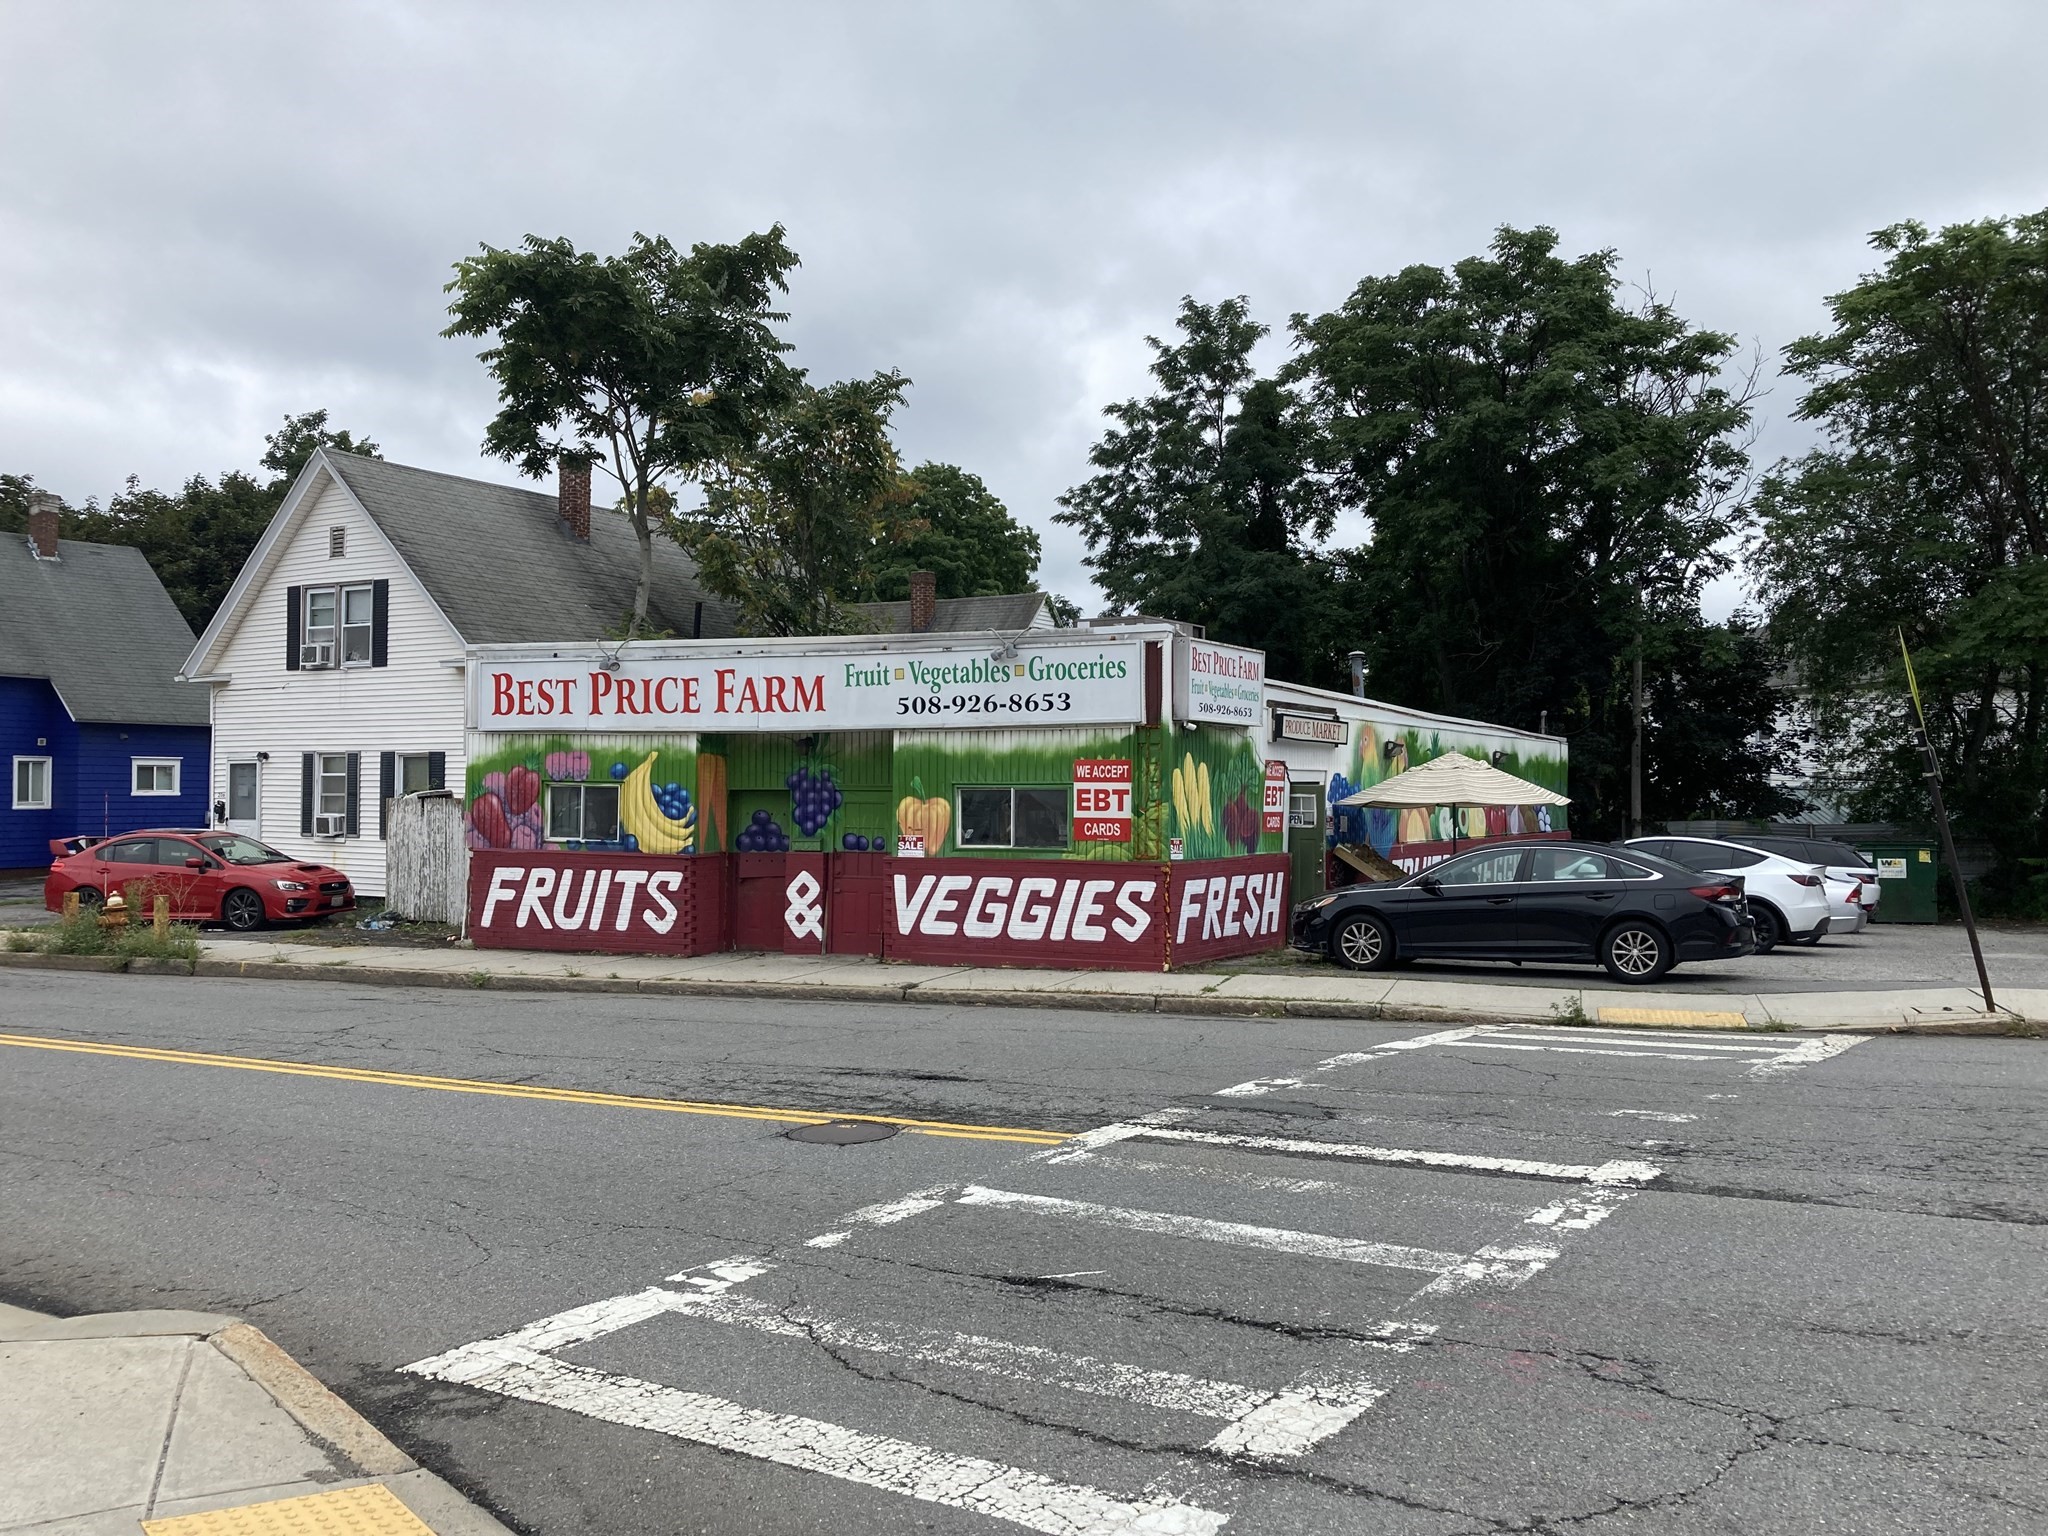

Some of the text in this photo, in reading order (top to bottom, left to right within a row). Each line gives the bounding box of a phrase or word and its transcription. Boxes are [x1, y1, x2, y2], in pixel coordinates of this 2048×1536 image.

[844, 654, 1127, 694] Fruit Vegetables Groceries
[1191, 646, 1260, 682] BEST PRICE FARM
[491, 668, 826, 716] BEST PRICE FARM
[1191, 678, 1260, 702] Fruit Vegetables Groceries
[896, 692, 1072, 716] 508-926-8653
[1198, 702, 1253, 718] 508-926-8653
[1284, 719, 1341, 741] PRODUCE MARKET
[1076, 765, 1129, 778] WE ACCEPT
[1076, 788, 1130, 812] EBT
[1264, 785, 1284, 807] EBT
[1084, 822, 1121, 836] CARDS
[1266, 816, 1281, 828] CARDS
[1289, 814, 1302, 825] PEN
[898, 841, 924, 850] SALE
[1170, 844, 1183, 854] SALE
[480, 867, 684, 934] FRUITS
[784, 870, 823, 942] &
[893, 873, 1157, 943] VEGGIES
[1176, 871, 1284, 945] FRESH
